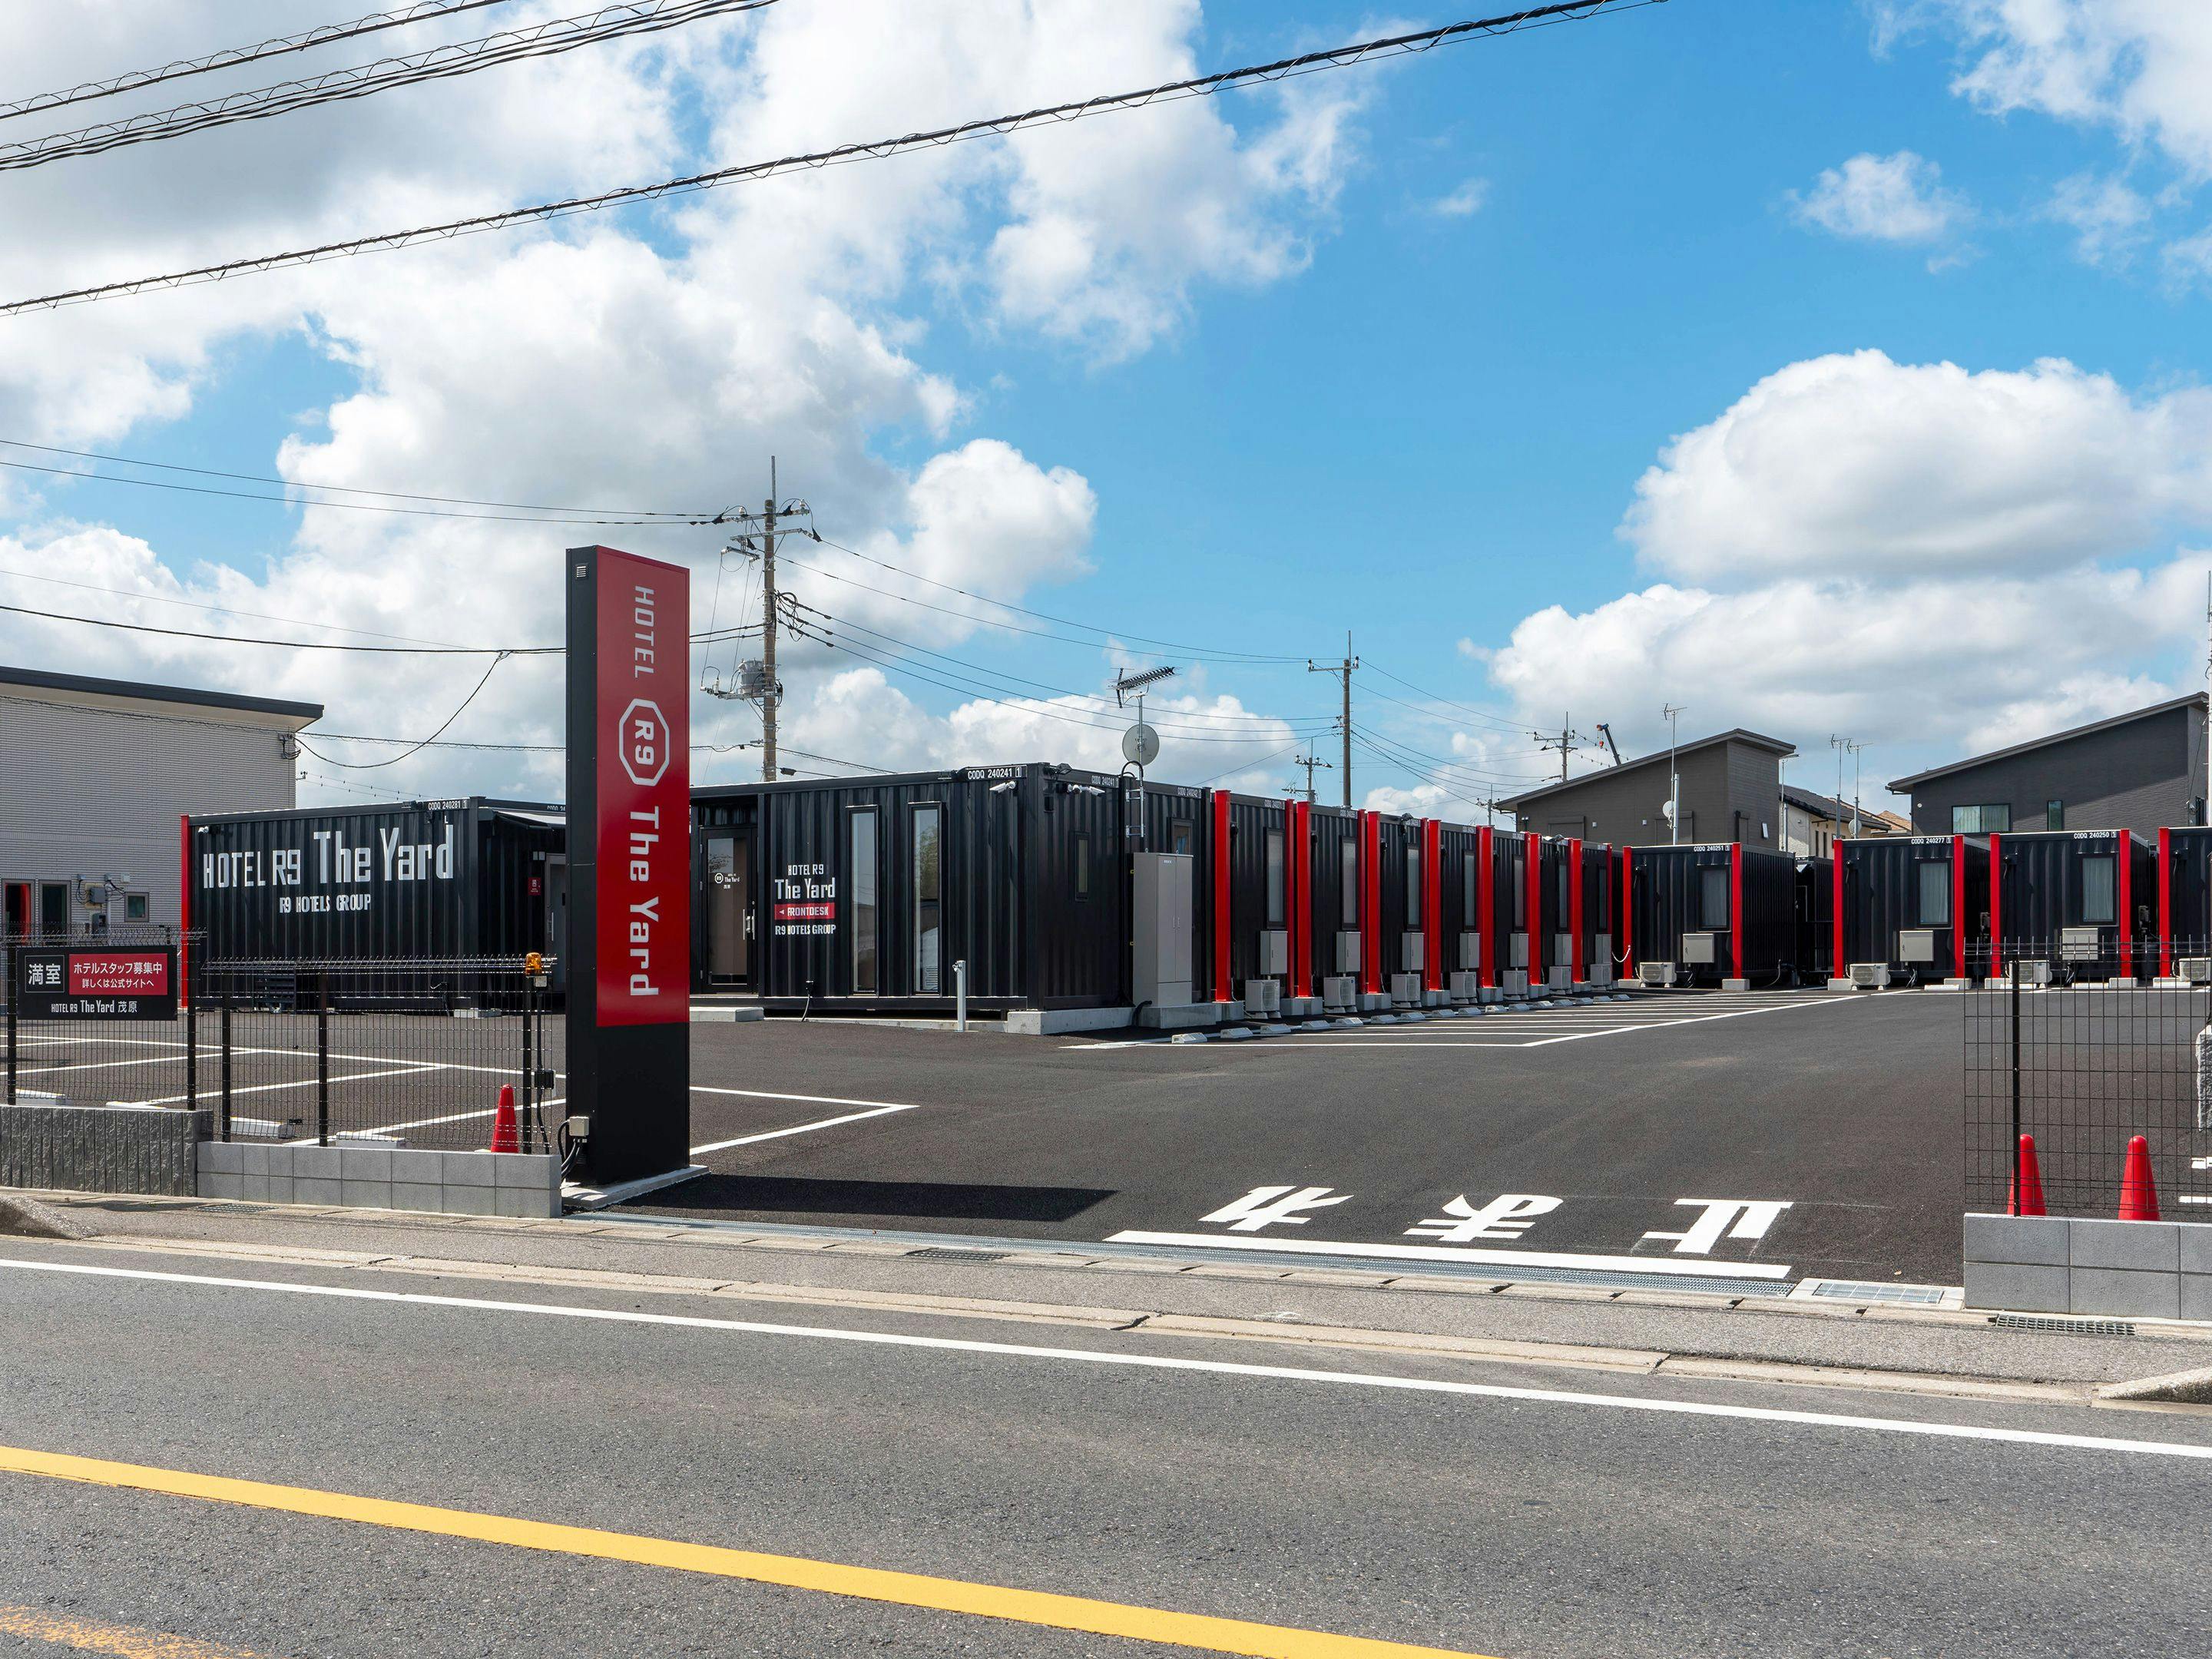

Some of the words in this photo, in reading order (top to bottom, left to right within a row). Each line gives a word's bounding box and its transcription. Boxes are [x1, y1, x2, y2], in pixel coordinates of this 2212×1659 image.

[634, 584, 654, 678] HOTEL
[634, 719, 654, 765] R9
[968, 770, 985, 780] CODQ
[988, 767, 1012, 778] 240241
[428, 803, 441, 811] CODQ
[442, 800, 461, 810] 240281
[629, 806, 659, 882] The
[203, 850, 267, 889] HOTEL
[272, 849, 301, 886] R9
[313, 830, 371, 884] The
[379, 823, 454, 882] Yard
[788, 864, 810, 876] HOTEL
[813, 863, 824, 875] R9
[774, 878, 801, 899] The
[804, 877, 836, 899] Yard
[279, 896, 292, 914] R9
[296, 895, 330, 912] HOTELS
[336, 893, 372, 912] GROUP
[787, 906, 829, 917] FRONTDESK
[775, 926, 786, 935] R9
[787, 925, 811, 935] HOTELS
[812, 924, 836, 935] GROUP
[629, 896, 659, 995] Yard
[28, 963, 61, 986] 満室
[74, 962, 162, 975] ホテルスタッフ募集中
[81, 979, 154, 988] 詳しくは公式サイトへ
[51, 1003, 69, 1013] HOTEL
[70, 1003, 78, 1012] R9
[80, 1000, 95, 1013] The
[96, 1000, 114, 1013] Yard
[118, 1001, 137, 1013] 茂原
